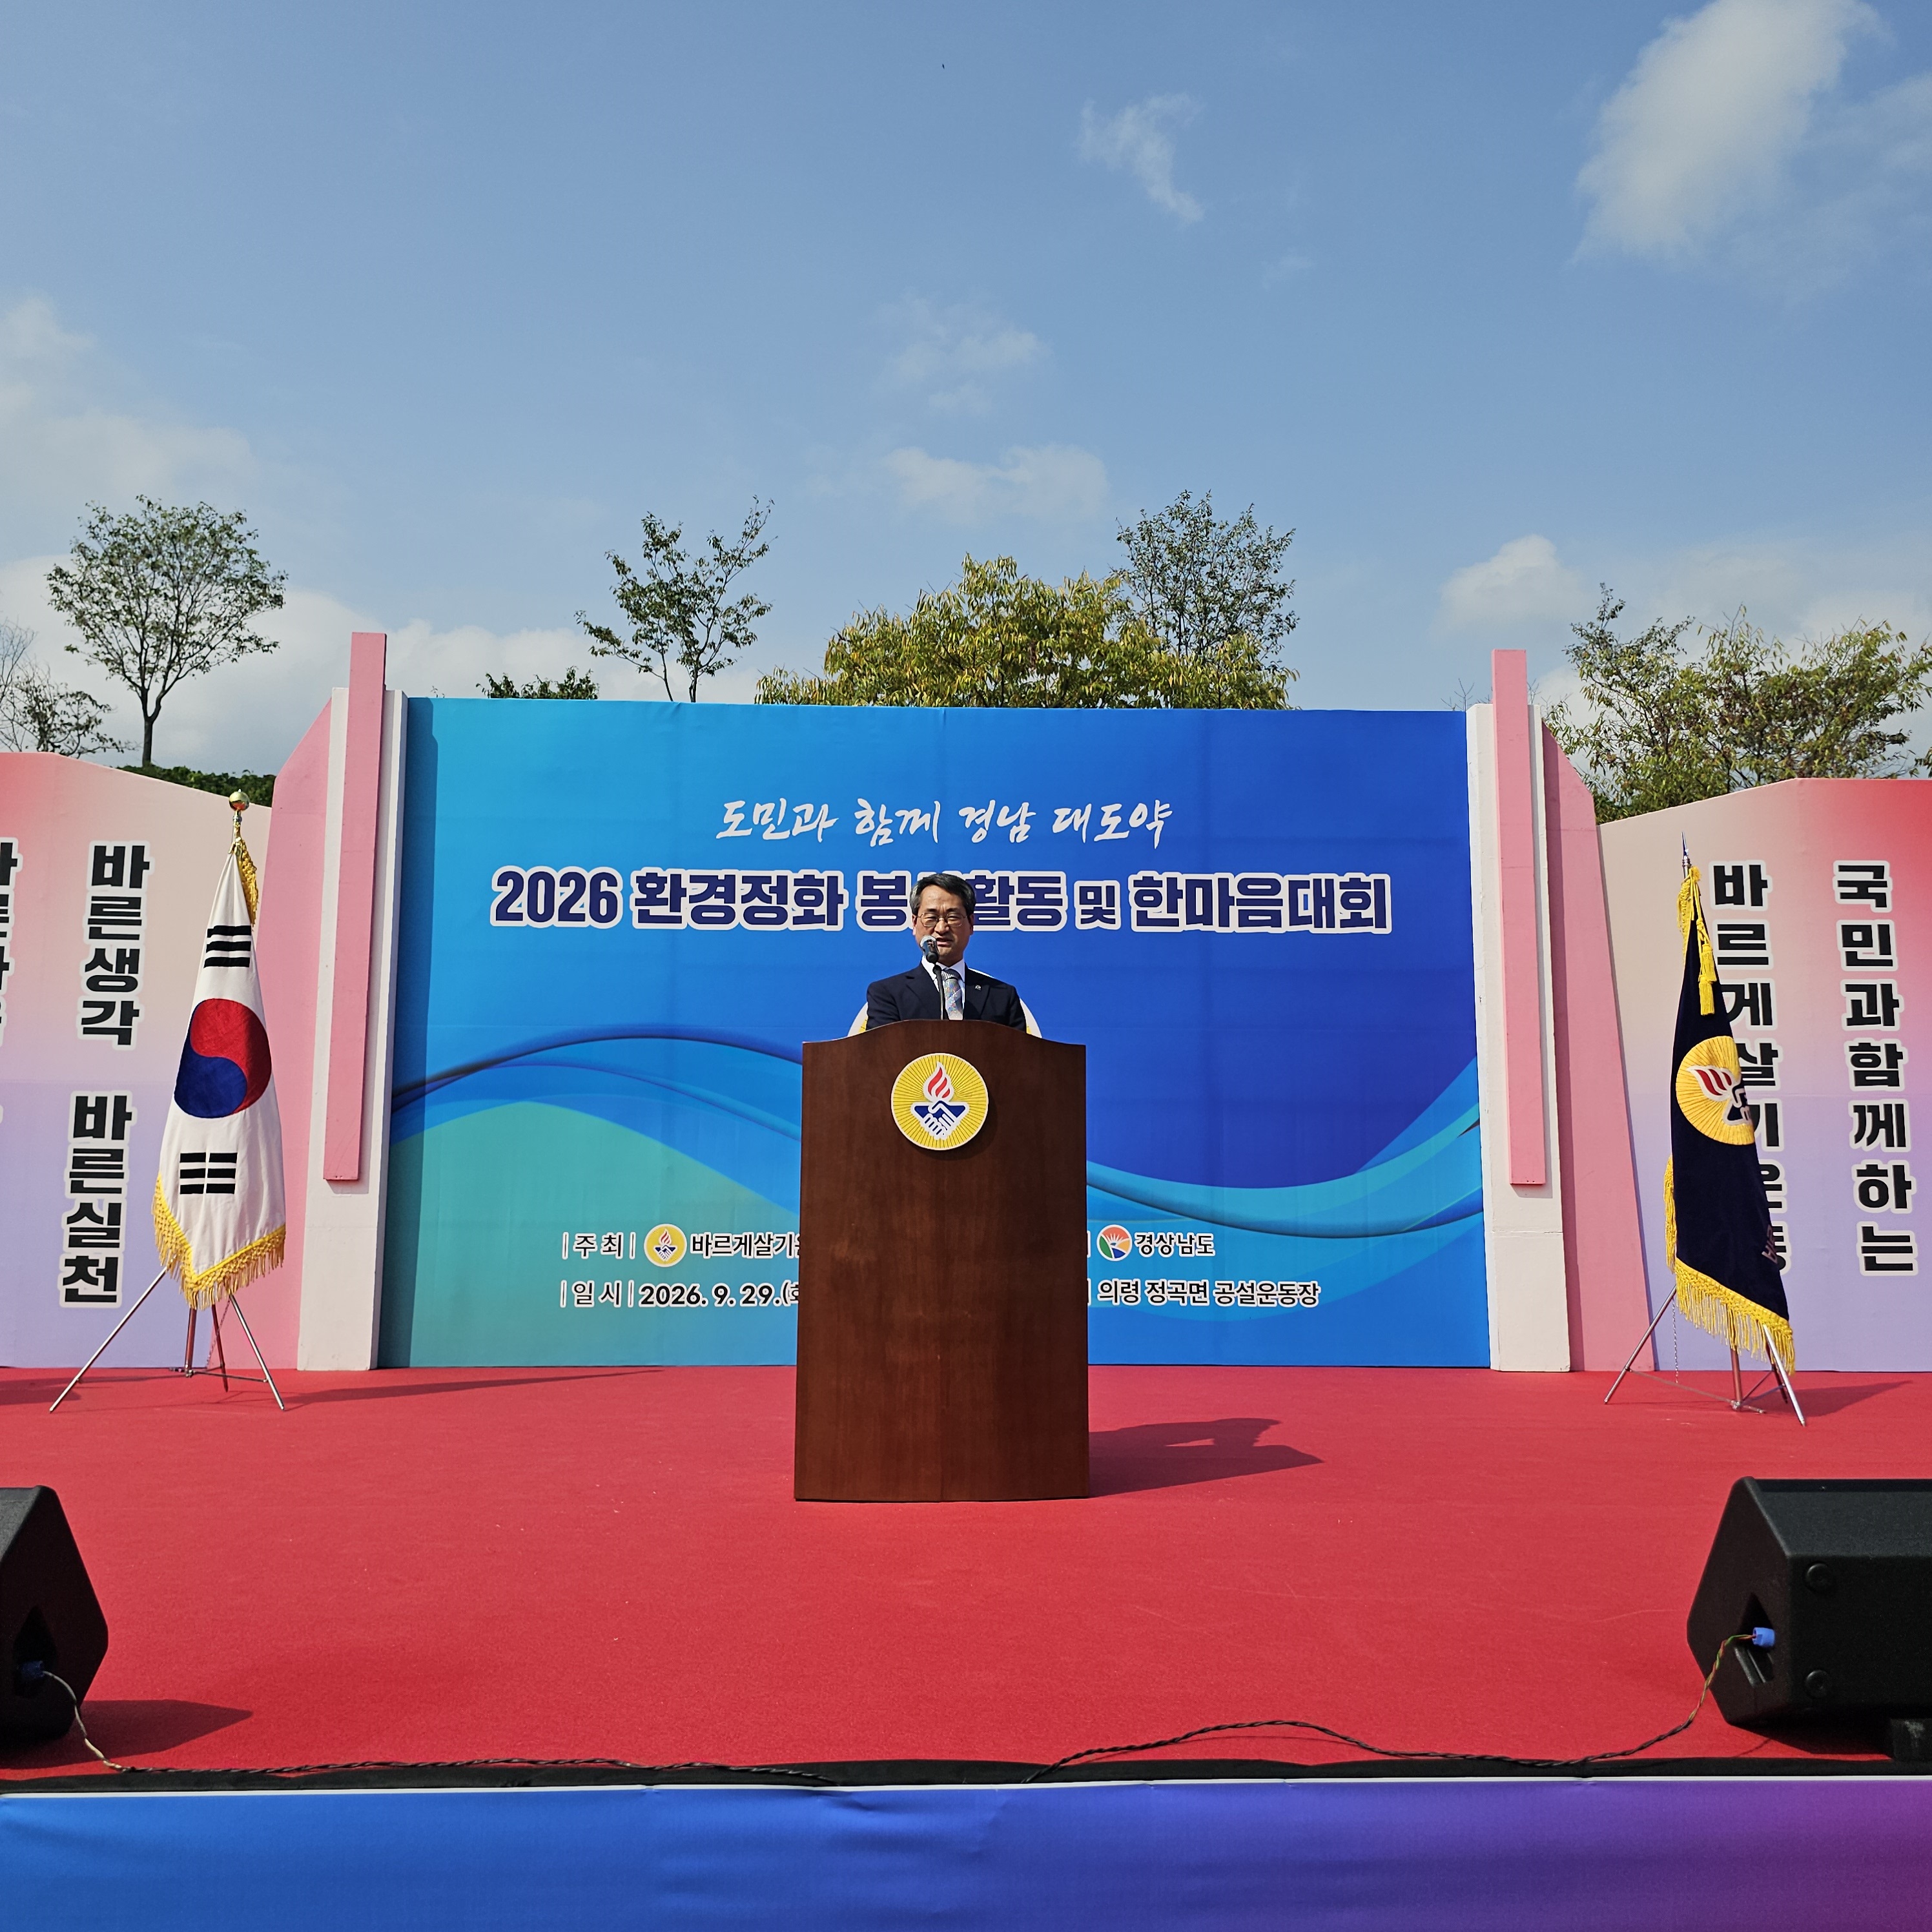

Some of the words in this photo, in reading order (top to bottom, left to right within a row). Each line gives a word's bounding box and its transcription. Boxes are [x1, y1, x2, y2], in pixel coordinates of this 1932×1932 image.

[715, 797, 839, 842] 도민과
[854, 797, 941, 847] 함께
[958, 799, 1036, 843] 경남
[1052, 799, 1173, 849] 대도약
[493, 869, 619, 923] 2026
[632, 869, 844, 927] 환경정화
[859, 872, 1065, 928] 봉활동
[1078, 883, 1118, 926] 및
[1132, 875, 1388, 930] 한마음대회
[79, 844, 151, 1047] 바른생각
[59, 1093, 134, 1305] 바른실천
[691, 1233, 800, 1257] 바르게살기
[1135, 1233, 1215, 1256] 경상남도
[639, 1284, 708, 1306] 2026.
[712, 1284, 735, 1306] 9.
[1098, 1280, 1140, 1305] 의령
[1146, 1280, 1209, 1306] 정곡면
[1213, 1281, 1320, 1307] 공설운동장
